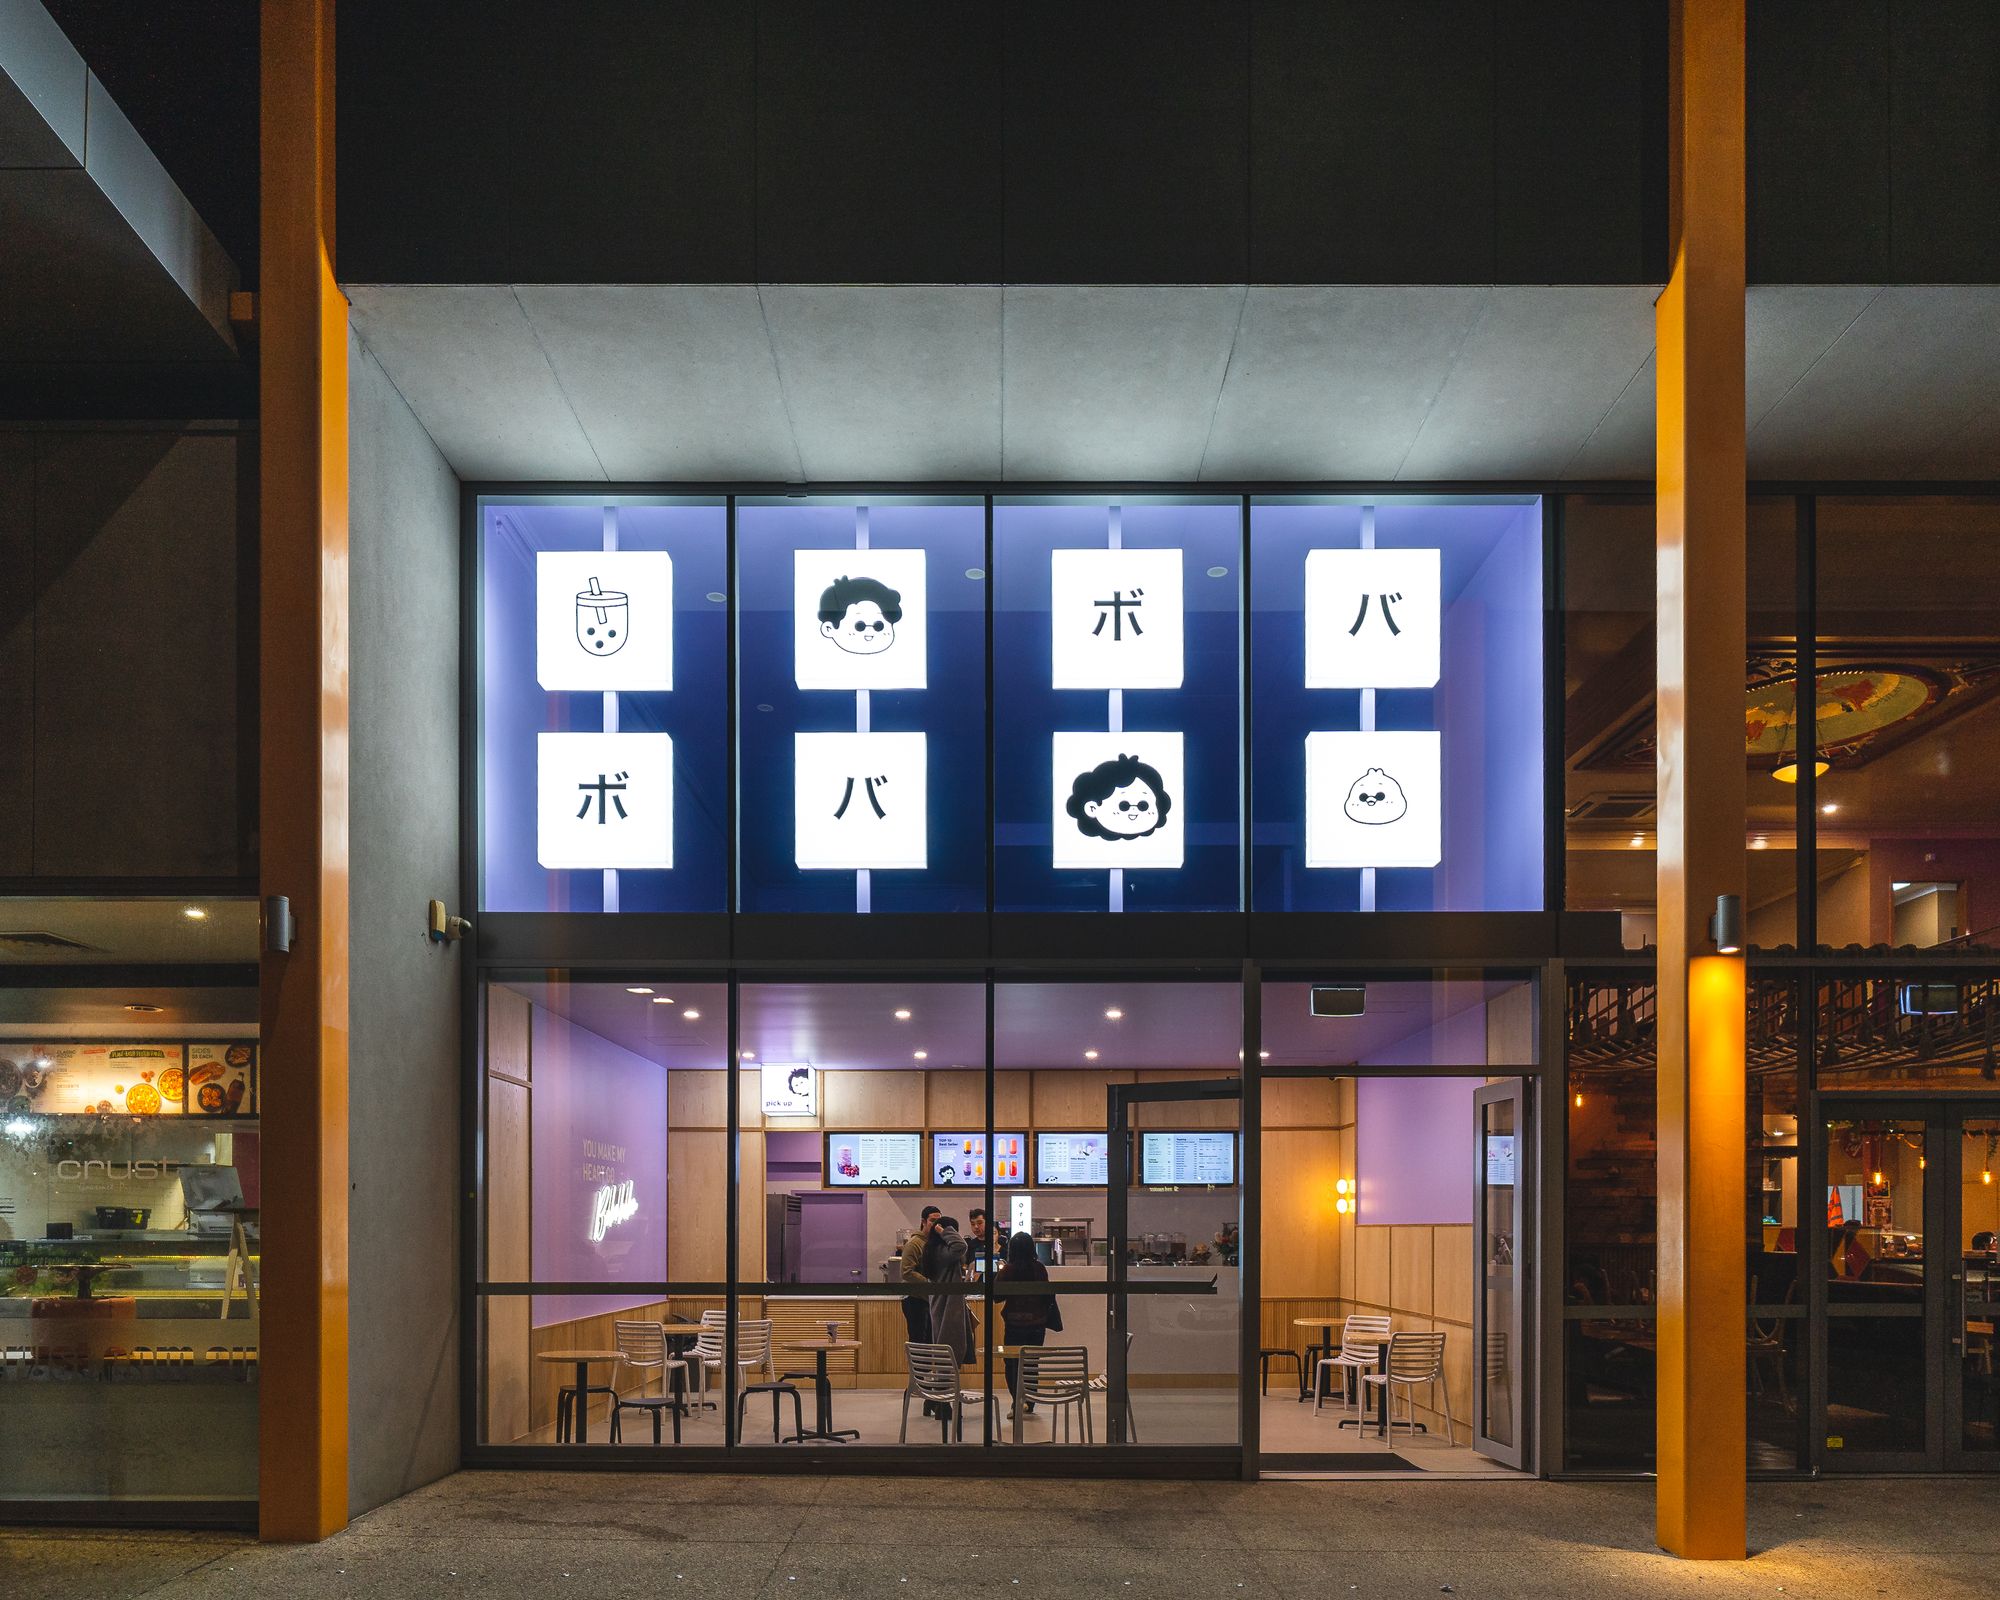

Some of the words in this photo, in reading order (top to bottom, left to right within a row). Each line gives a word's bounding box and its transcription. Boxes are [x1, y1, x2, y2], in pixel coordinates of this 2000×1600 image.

[1093, 588, 1144, 641] ボ
[1348, 592, 1403, 637] バ
[576, 770, 630, 825] ボ
[834, 775, 888, 820] バ
[583, 1138, 597, 1159] YOU
[597, 1142, 616, 1162] MAKE
[616, 1146, 626, 1164] MY
[57, 1156, 180, 1180] crust
[583, 1162, 605, 1184] HEART
